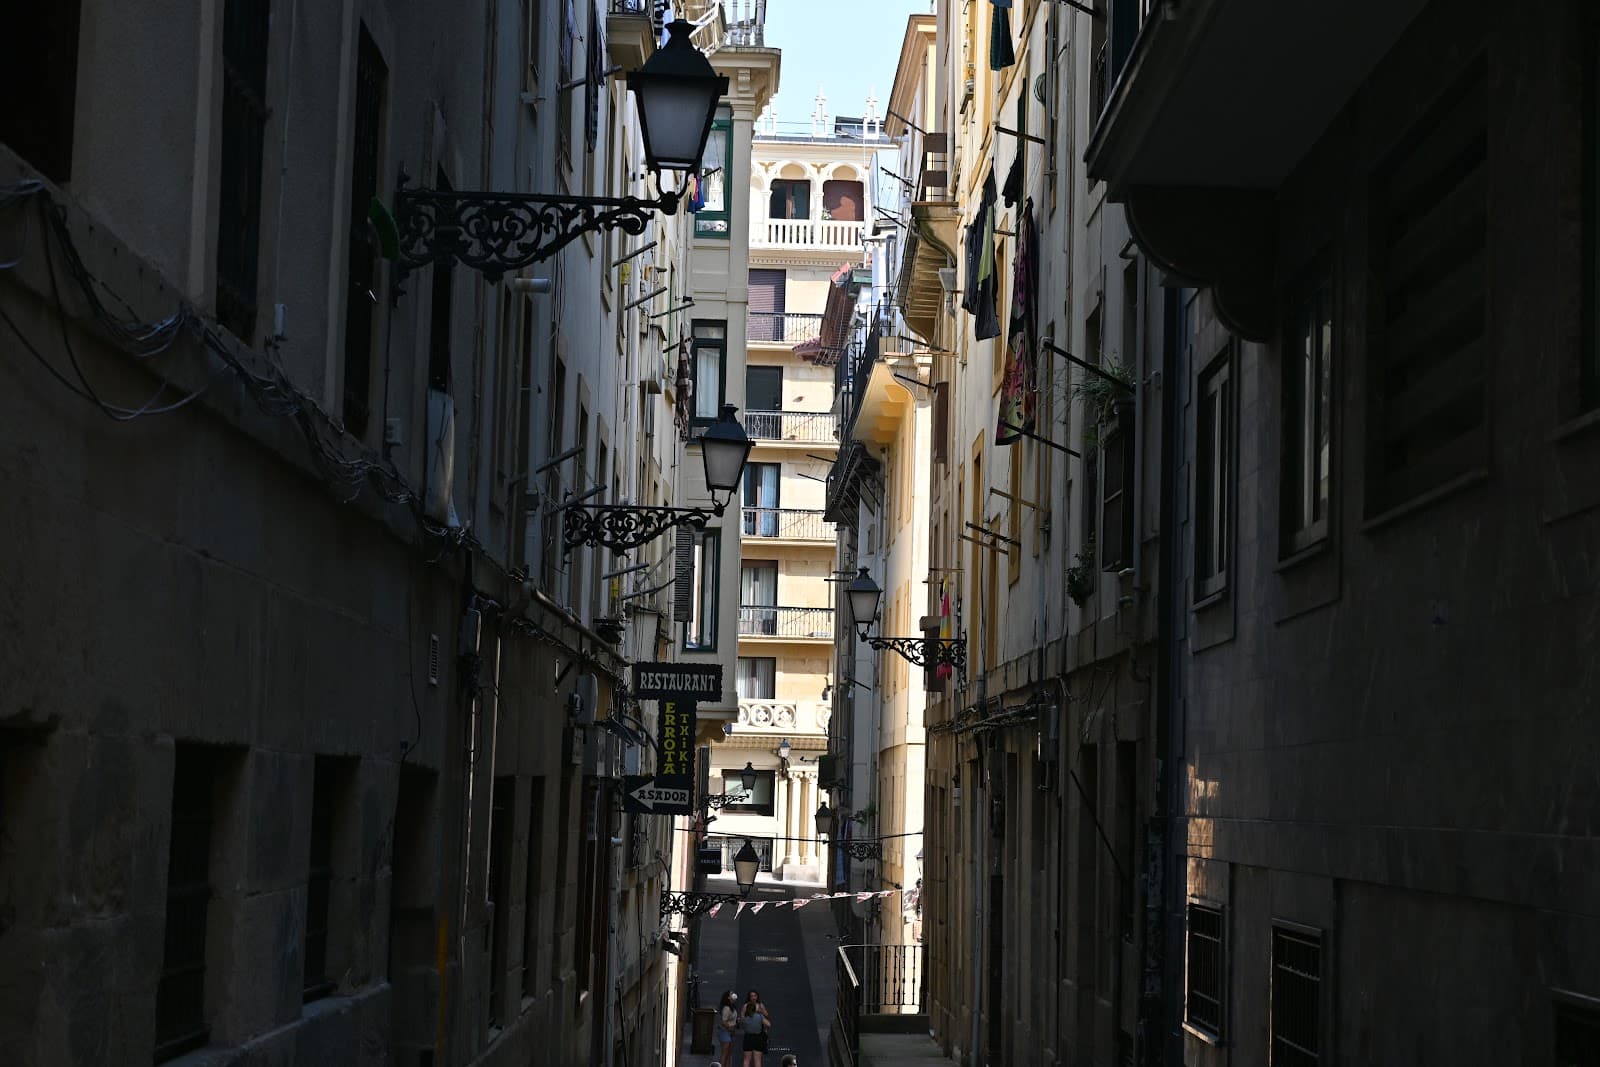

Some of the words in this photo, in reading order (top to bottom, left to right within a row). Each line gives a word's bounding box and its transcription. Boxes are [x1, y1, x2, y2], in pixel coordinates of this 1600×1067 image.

[640, 672, 715, 691] RESTAURANT
[663, 702, 677, 775] ERROTA
[638, 789, 687, 801] ASADOR
